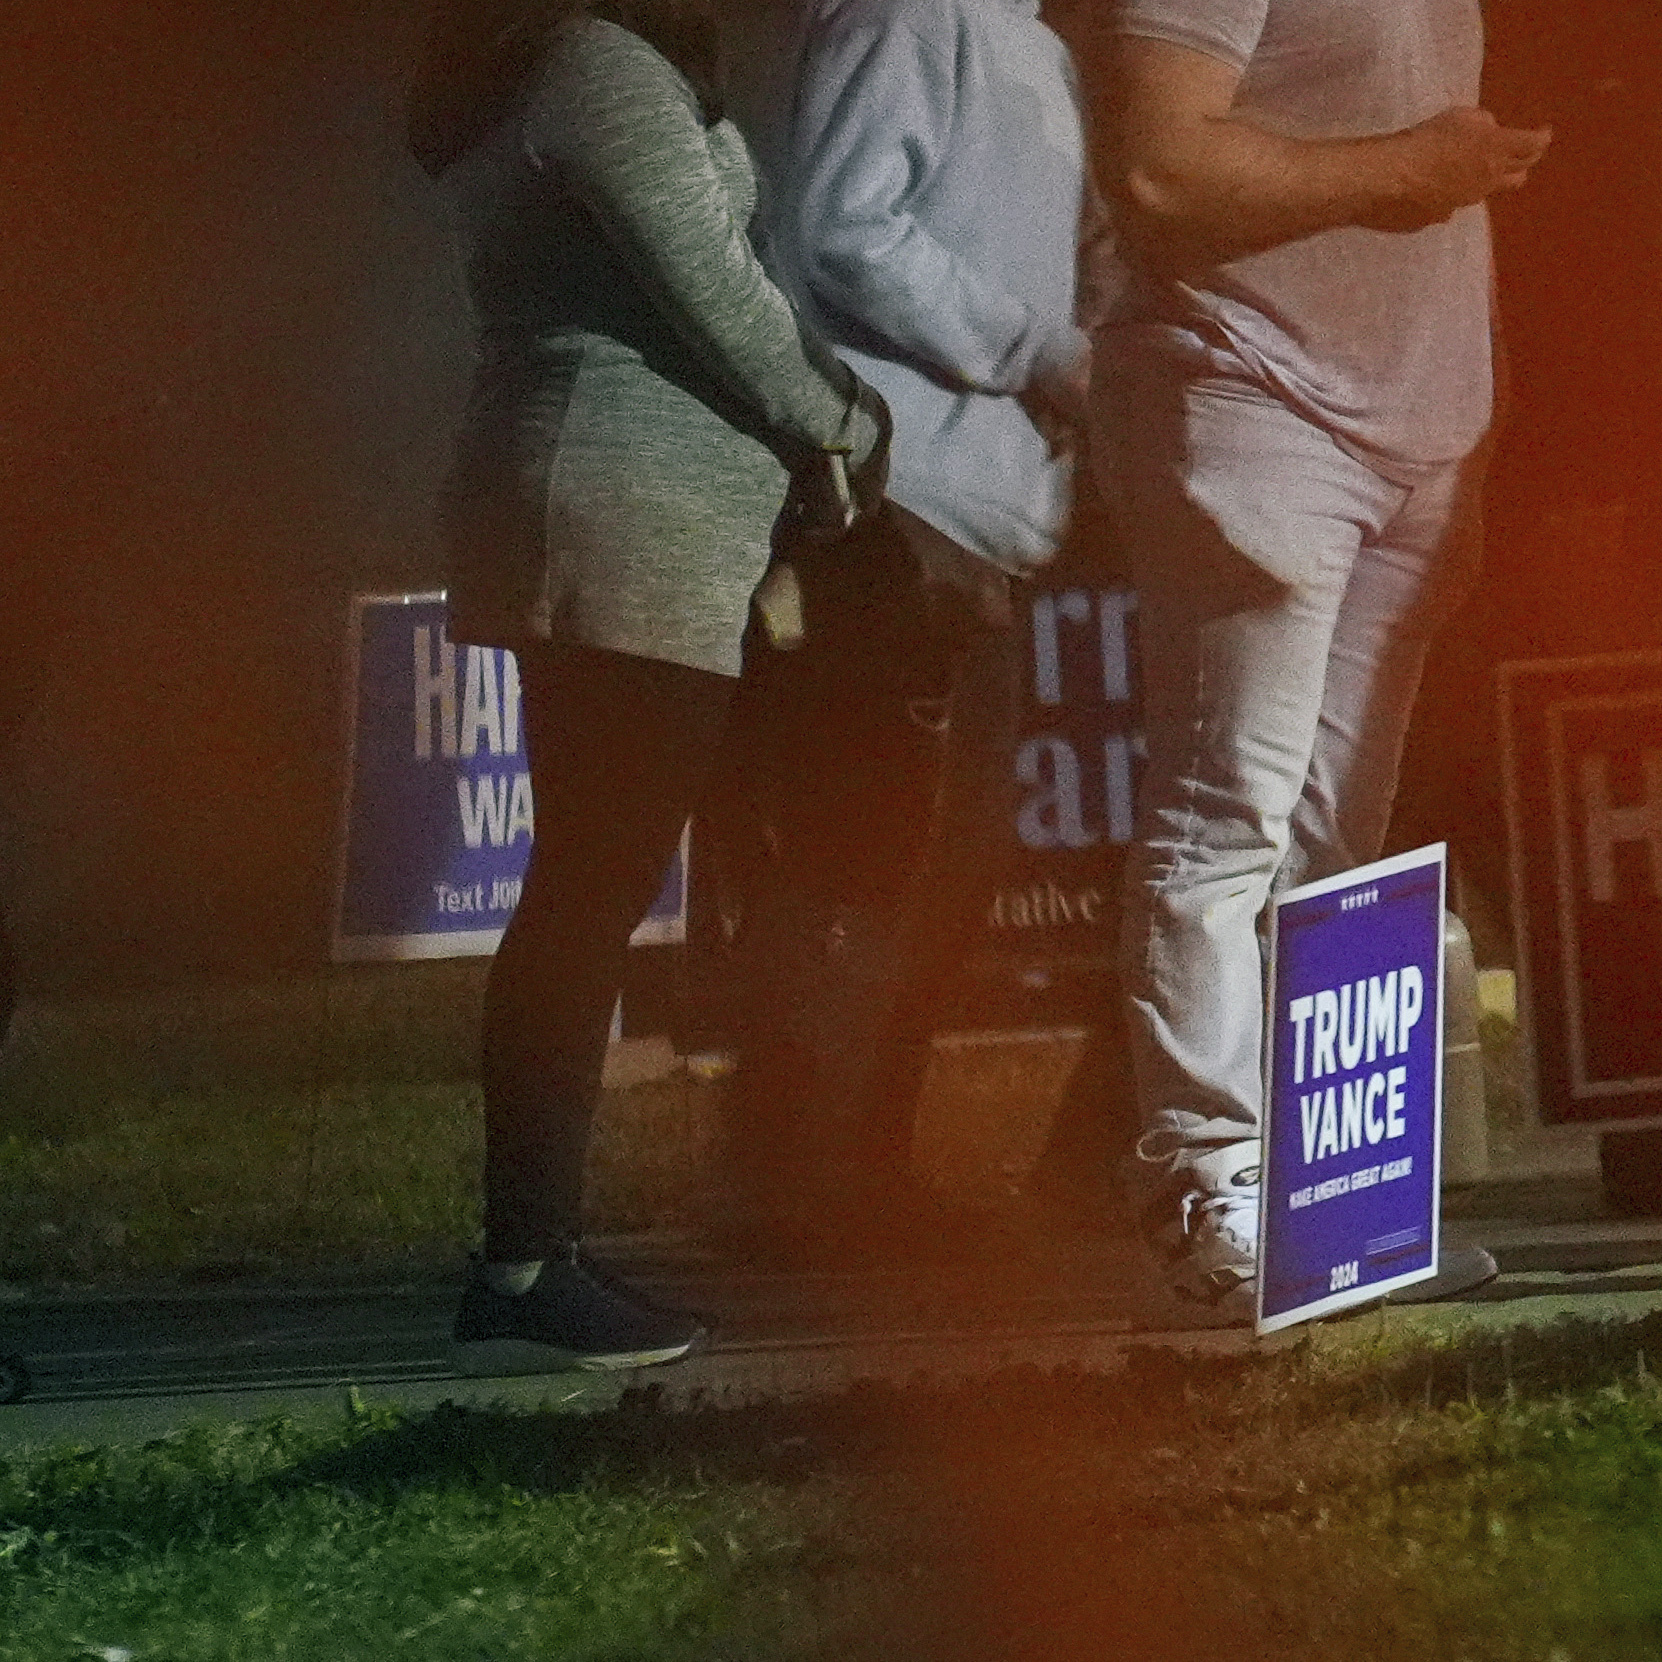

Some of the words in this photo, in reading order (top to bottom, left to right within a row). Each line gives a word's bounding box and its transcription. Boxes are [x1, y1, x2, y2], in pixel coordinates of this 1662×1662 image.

[433, 883, 485, 913] Text
[1290, 966, 1423, 1084] TRUMP
[1300, 1067, 1407, 1165] VANCE
